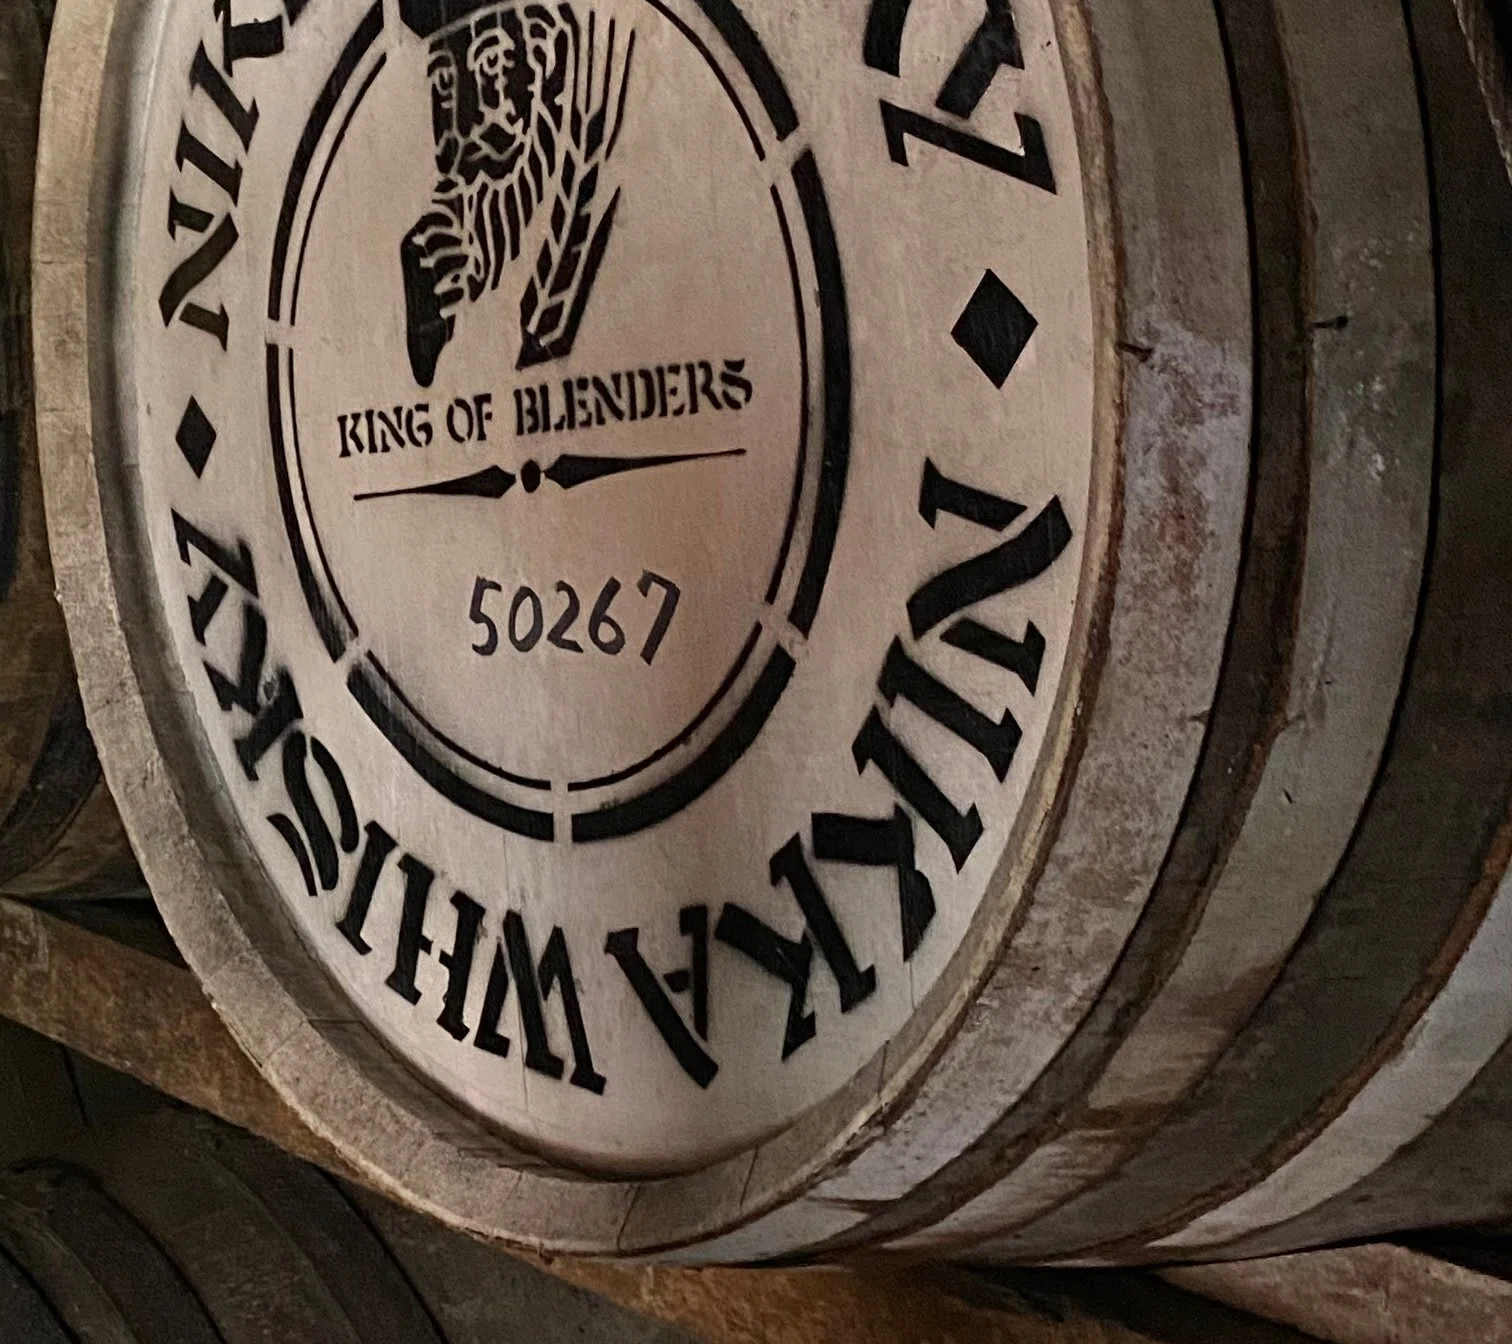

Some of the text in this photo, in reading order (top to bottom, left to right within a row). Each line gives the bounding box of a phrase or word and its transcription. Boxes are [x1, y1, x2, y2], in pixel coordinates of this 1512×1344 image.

[336, 358, 754, 459] KING OF BLENDERS
[468, 568, 682, 667] 50267
[604, 457, 1076, 1092] NIKKA
[168, 502, 608, 1097] WHISKY
